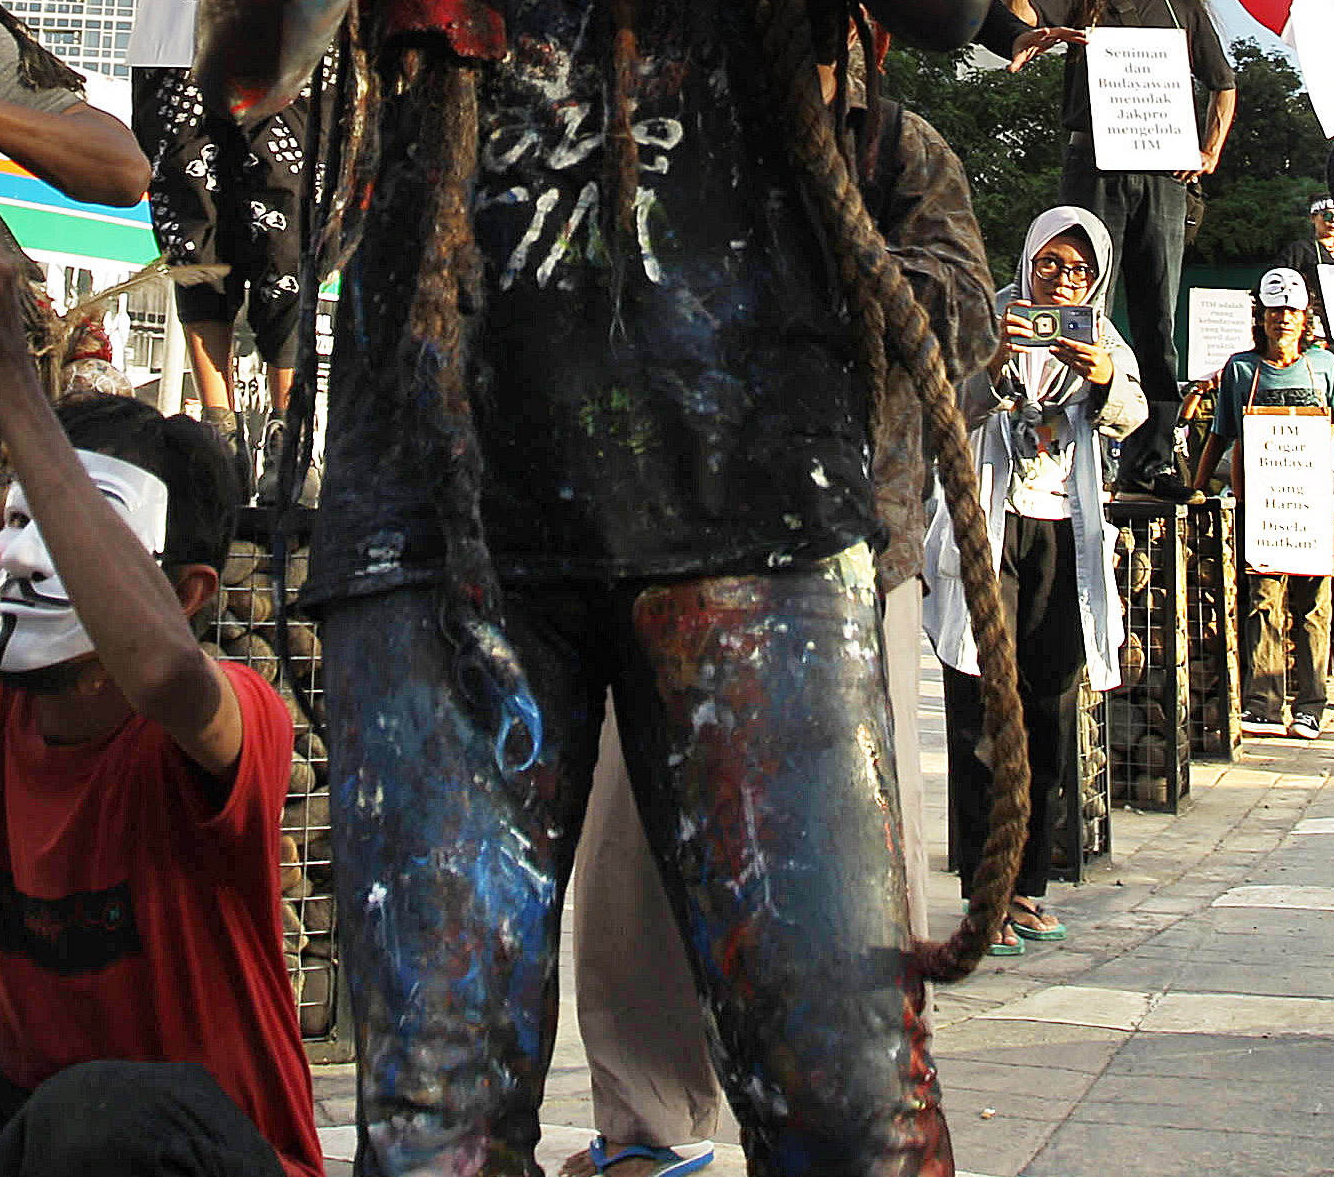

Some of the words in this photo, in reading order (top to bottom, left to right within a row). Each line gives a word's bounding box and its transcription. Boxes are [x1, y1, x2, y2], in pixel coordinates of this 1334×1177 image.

[1105, 47, 1168, 59] Seniman
[1125, 62, 1151, 74] dan
[1099, 77, 1181, 91] Budayawan
[1110, 93, 1172, 103] menolak
[1117, 109, 1168, 122] Jakpro
[1108, 123, 1182, 137] mengelola
[1132, 139, 1161, 150] TIM
[1269, 425, 1299, 436] TIM
[1264, 440, 1307, 453] Cagar
[1260, 457, 1313, 470] Budaya
[1270, 485, 1304, 495] yang
[1265, 498, 1310, 509] Harus
[1257, 537, 1318, 549] matkan!
